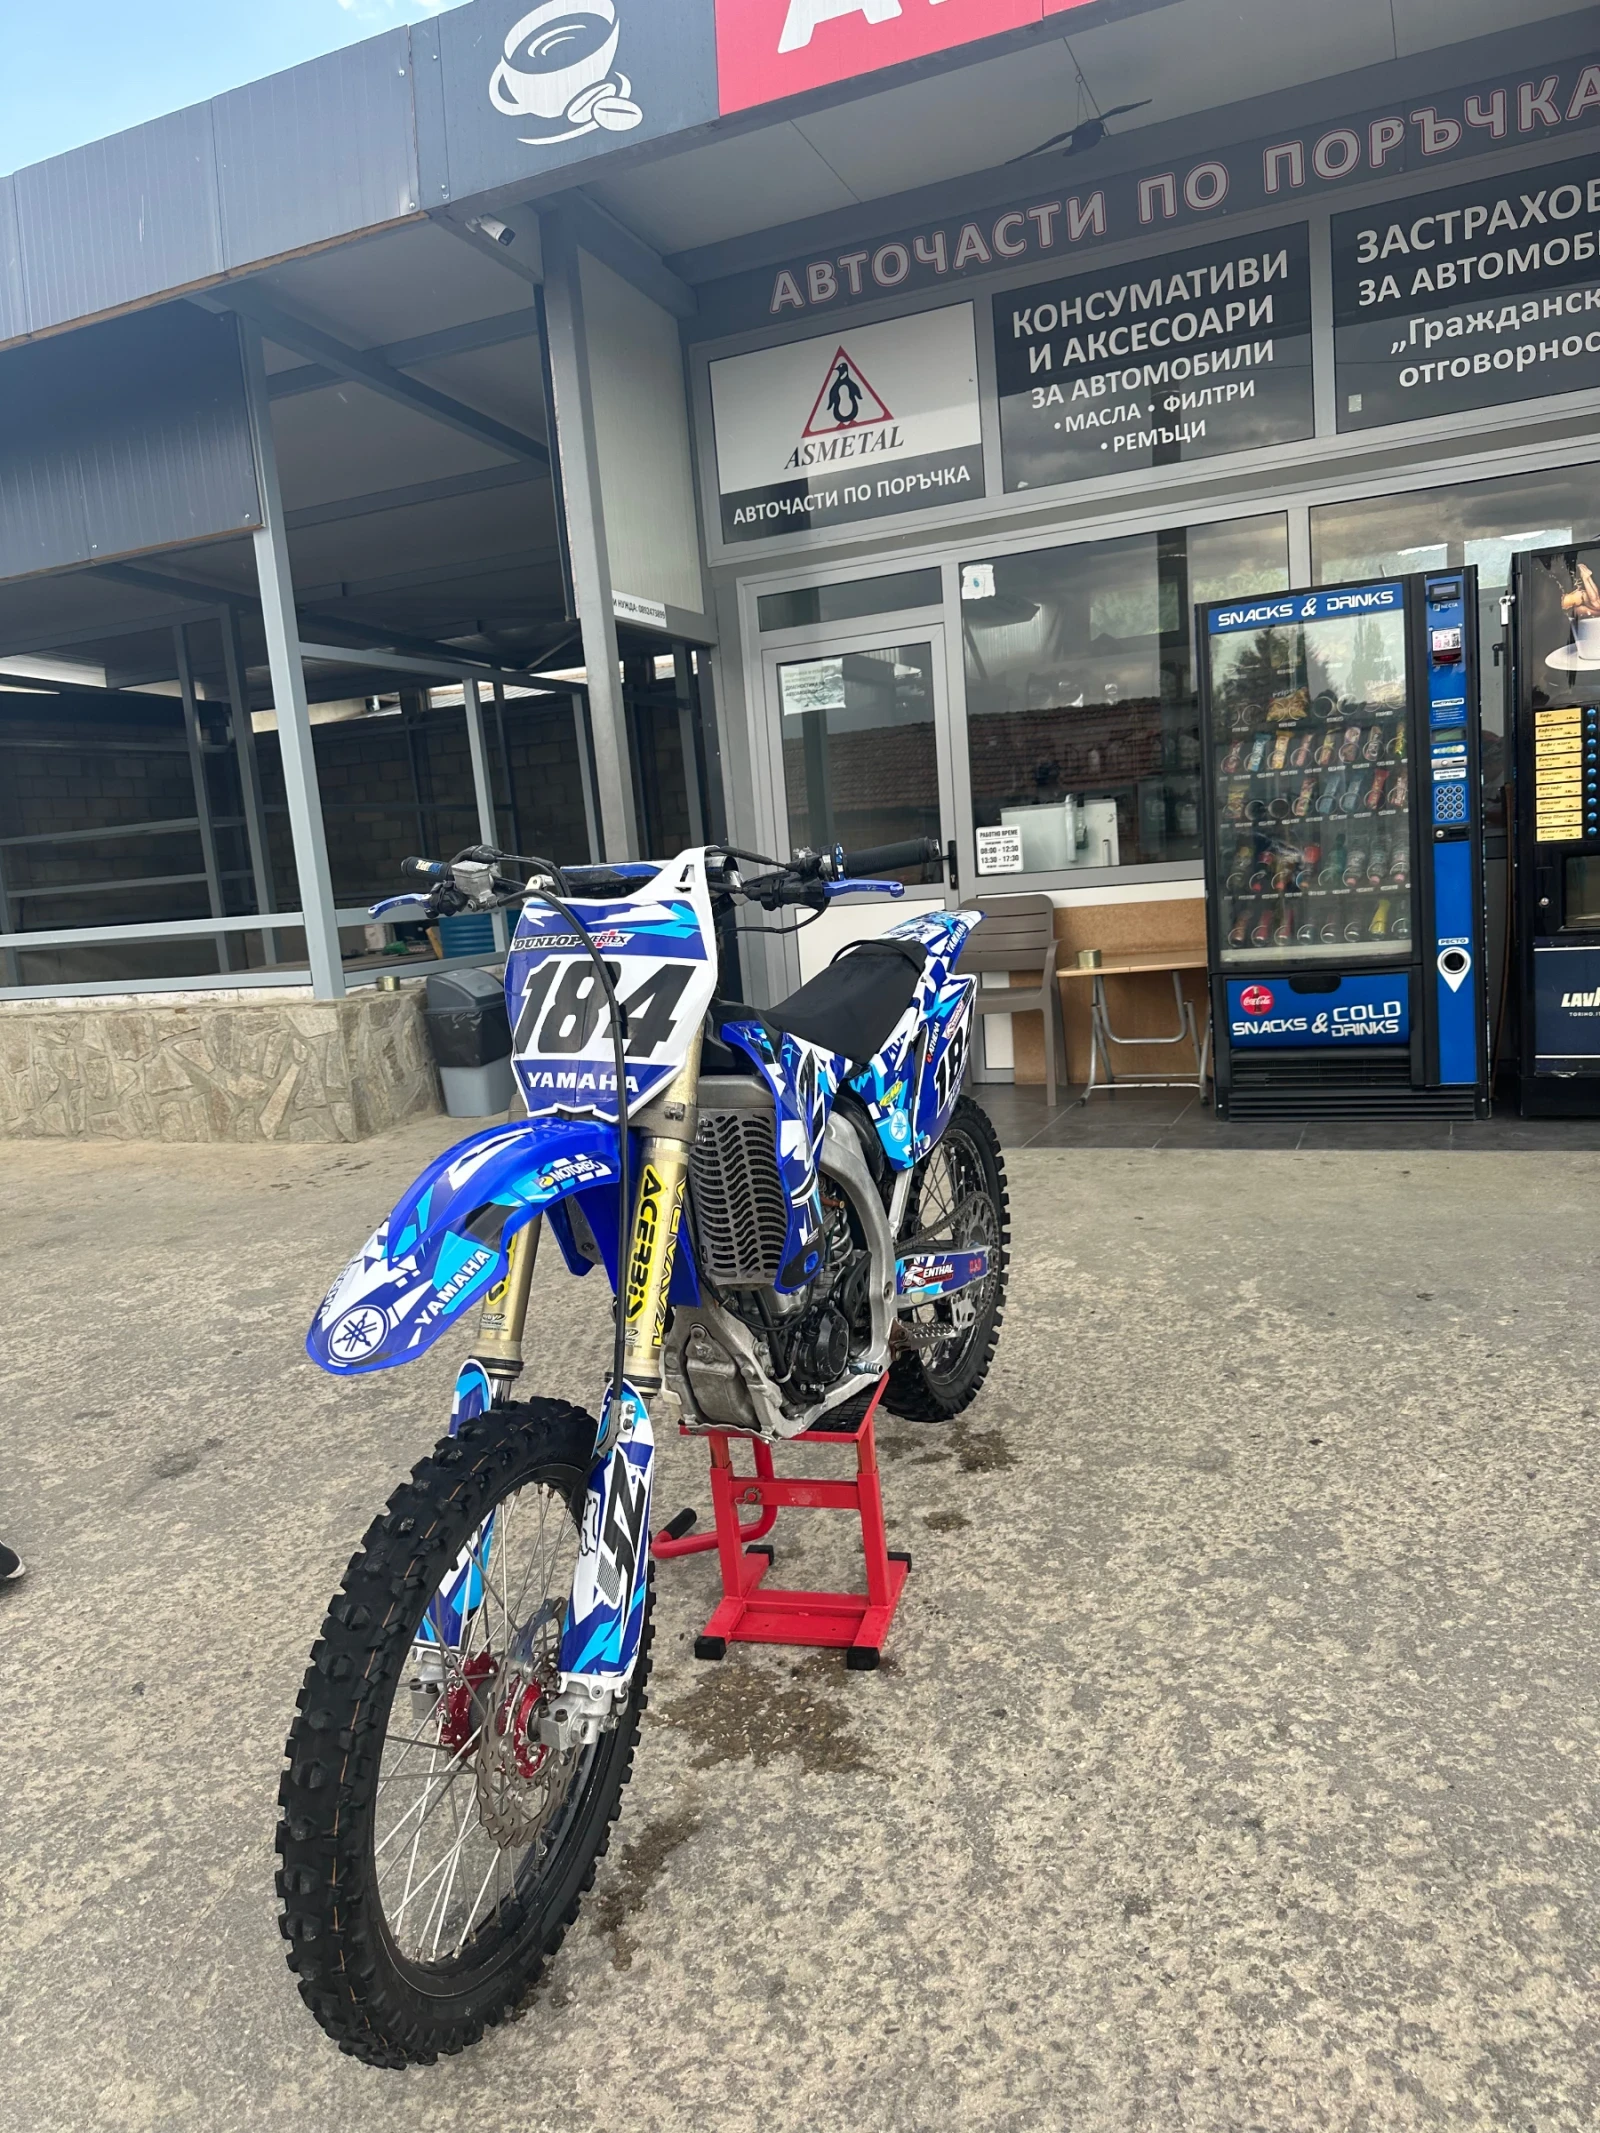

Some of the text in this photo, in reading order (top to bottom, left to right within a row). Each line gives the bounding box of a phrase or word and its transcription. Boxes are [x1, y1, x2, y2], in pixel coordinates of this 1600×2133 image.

[769, 65, 1600, 314] АВТОЧАСТИ ПО ПОРЪЧКА
[1012, 249, 1288, 339] КОНСУМАТИВИ
[1358, 230, 1600, 306] ЗА АВТОМОБ
[1029, 294, 1274, 374] И АКСЕСОАРИ
[1399, 331, 1600, 388] отговорнос
[1031, 339, 1274, 409] ЗА АВТОМОБИЛИ
[1065, 380, 1255, 432] МАСЛА ФИЛТРИ
[784, 426, 904, 470] ASMETAL
[1113, 420, 1206, 452] РЕМЪЦИ
[733, 465, 971, 525] АВТОЧАСТИ ПО ПОРЪЧКА
[1218, 591, 1394, 627] SNACKS & DRINKS
[514, 935, 580, 950] DUNLOP
[514, 961, 697, 1058] 184
[1232, 1012, 1399, 1037] SNACKS & DRINKS
[1333, 1001, 1401, 1022] COLD
[527, 1072, 639, 1092] YAMAHA
[549, 1160, 598, 1181] MOTOREX
[414, 1249, 492, 1326] YAMAHA
